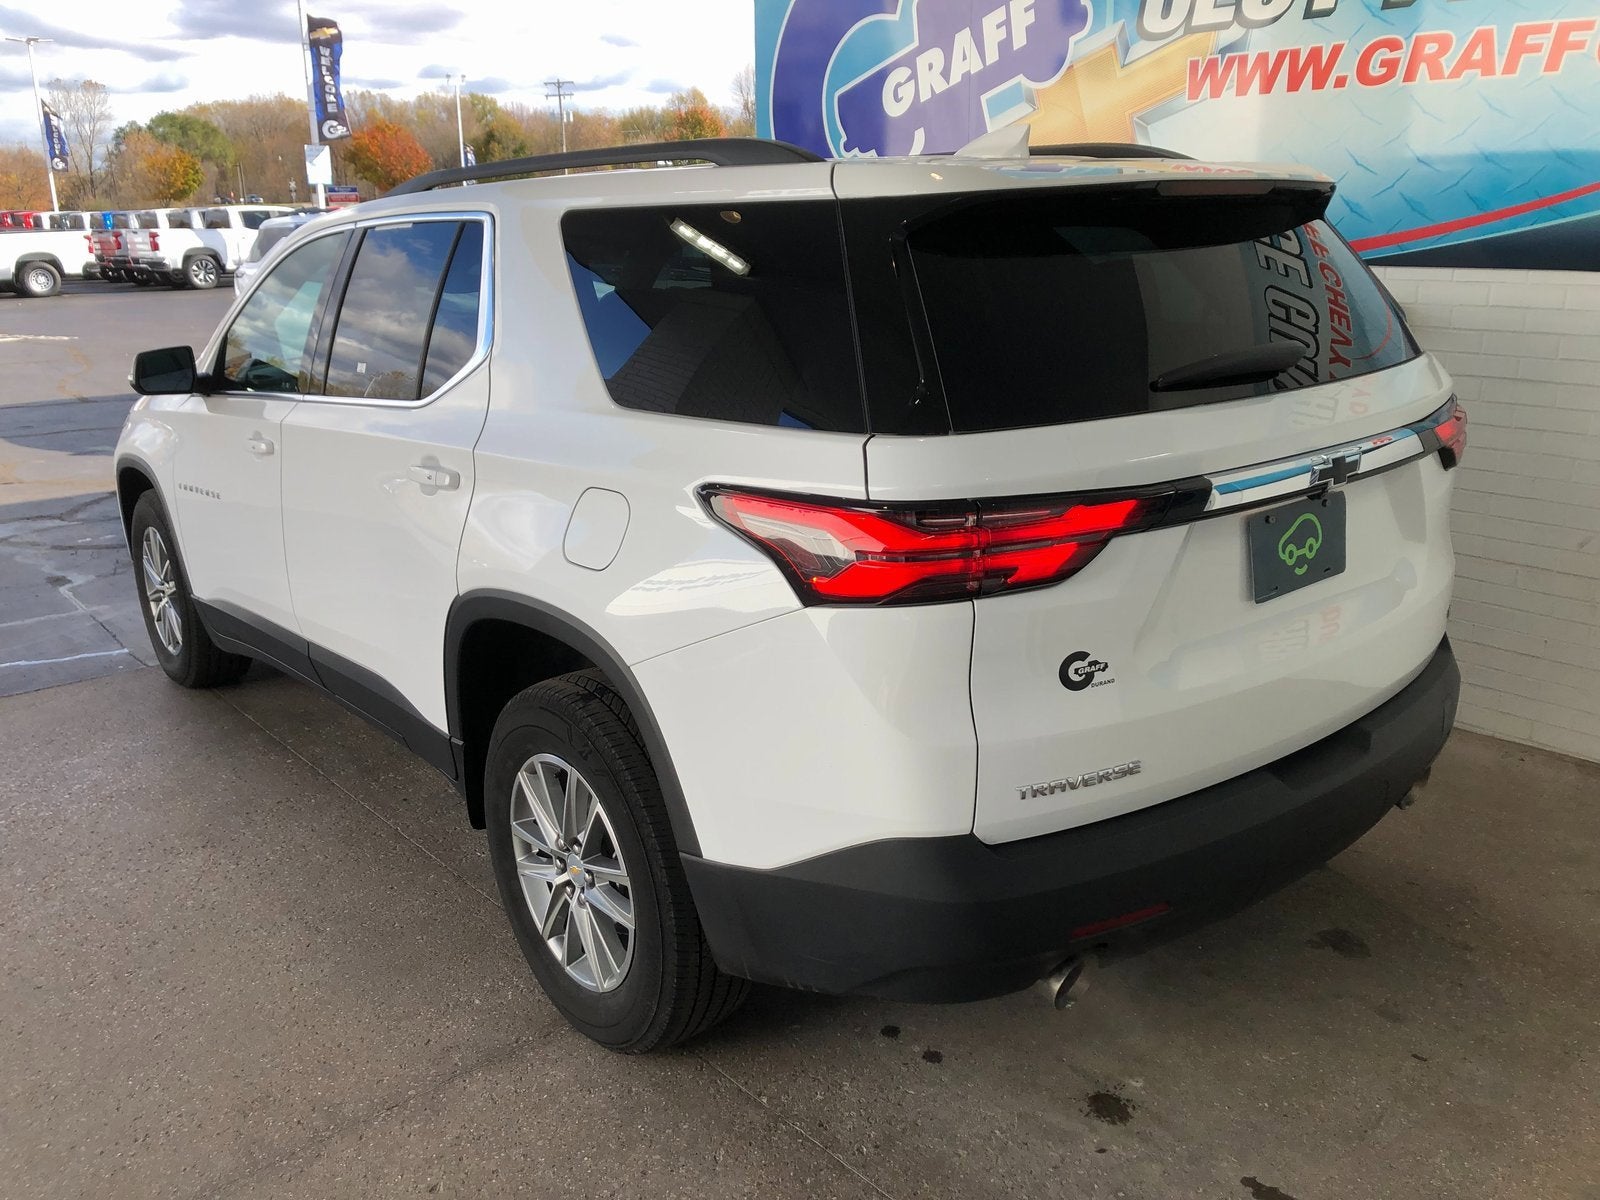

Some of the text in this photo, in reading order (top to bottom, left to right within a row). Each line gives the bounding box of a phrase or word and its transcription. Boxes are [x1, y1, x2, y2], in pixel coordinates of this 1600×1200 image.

[882, 0, 1036, 117] GRAFF
[1187, 17, 1600, 102] WWW.GRAFF
[1078, 662, 1107, 674] GRAFF
[1091, 678, 1115, 688] DURAND
[1016, 760, 1142, 800] TRAVERSE
